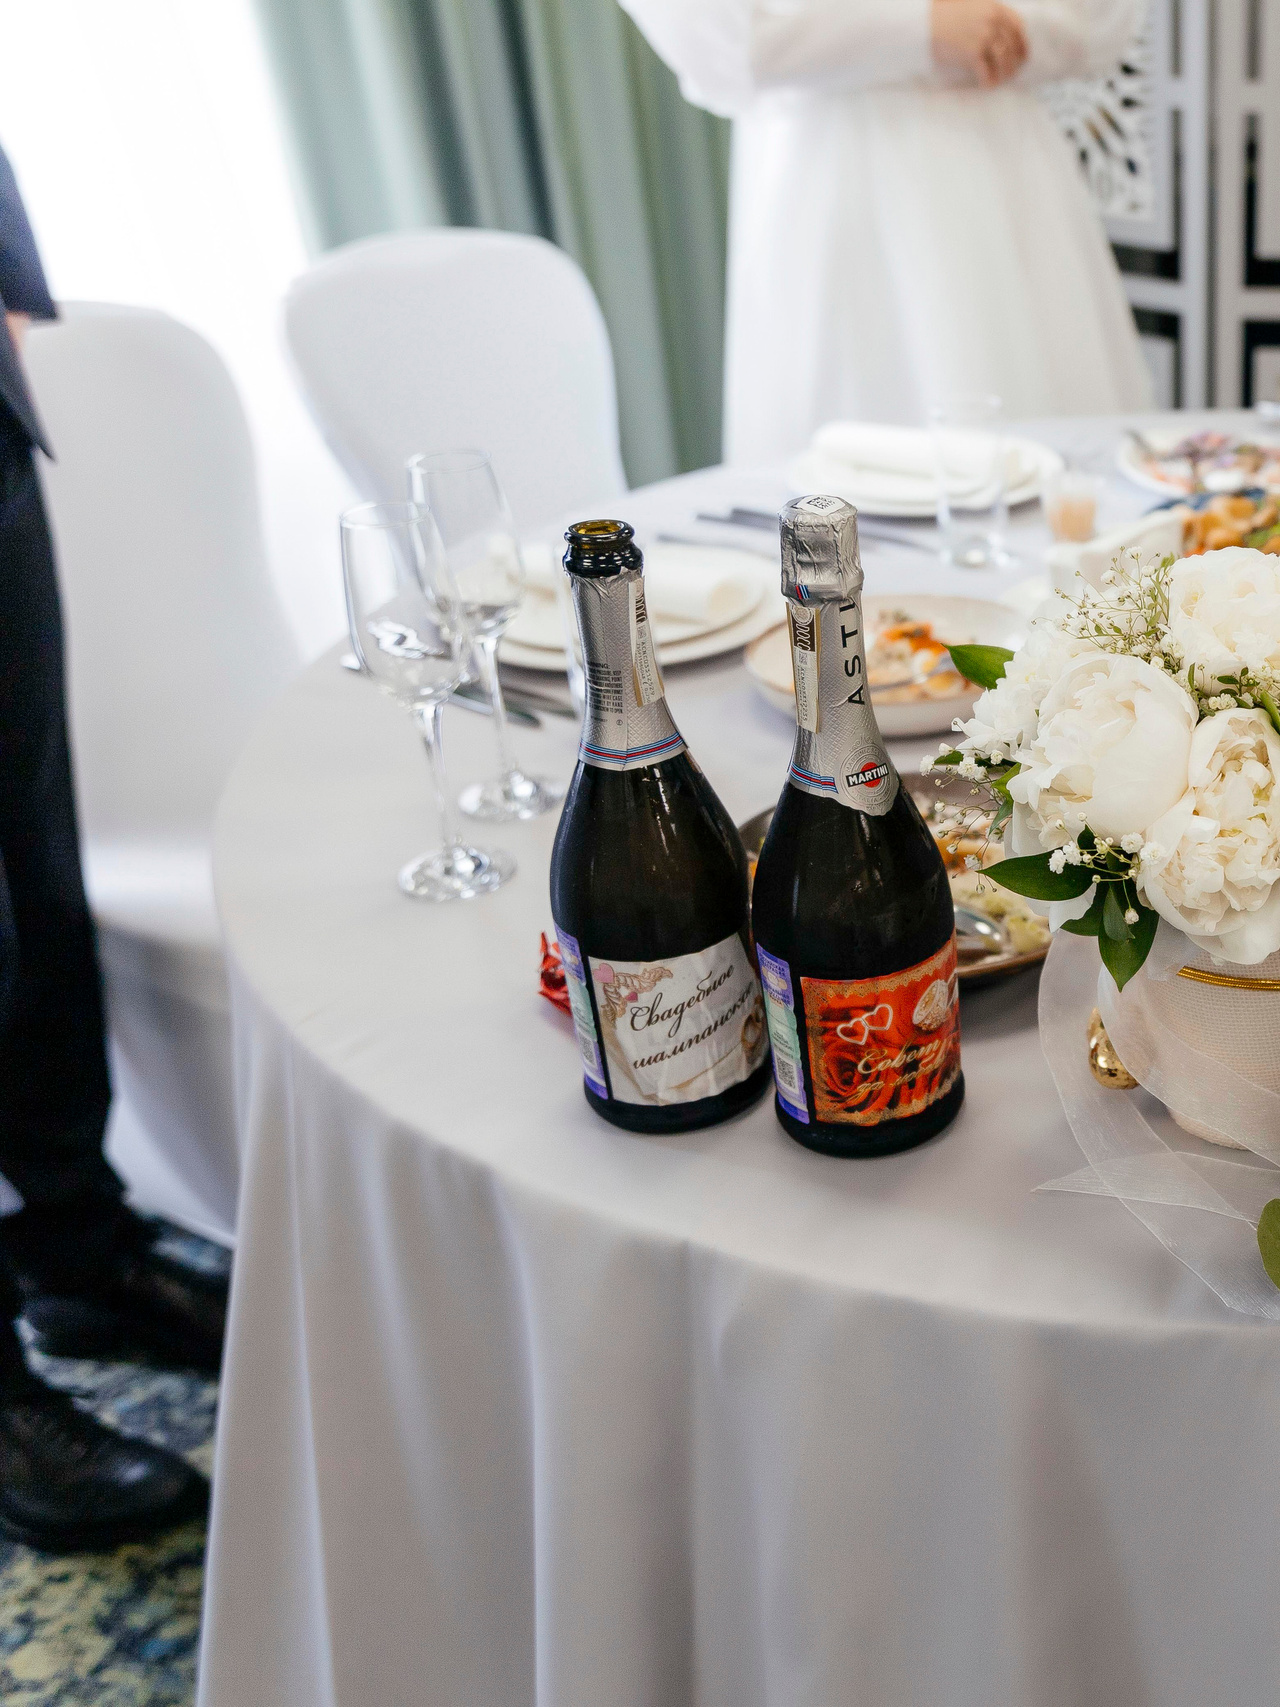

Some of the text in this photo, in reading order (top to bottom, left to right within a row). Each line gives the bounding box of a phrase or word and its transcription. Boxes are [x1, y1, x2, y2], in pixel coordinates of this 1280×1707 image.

[840, 602, 865, 705] ASTI
[848, 764, 888, 786] MARTINI
[630, 964, 735, 1038] Свадебное
